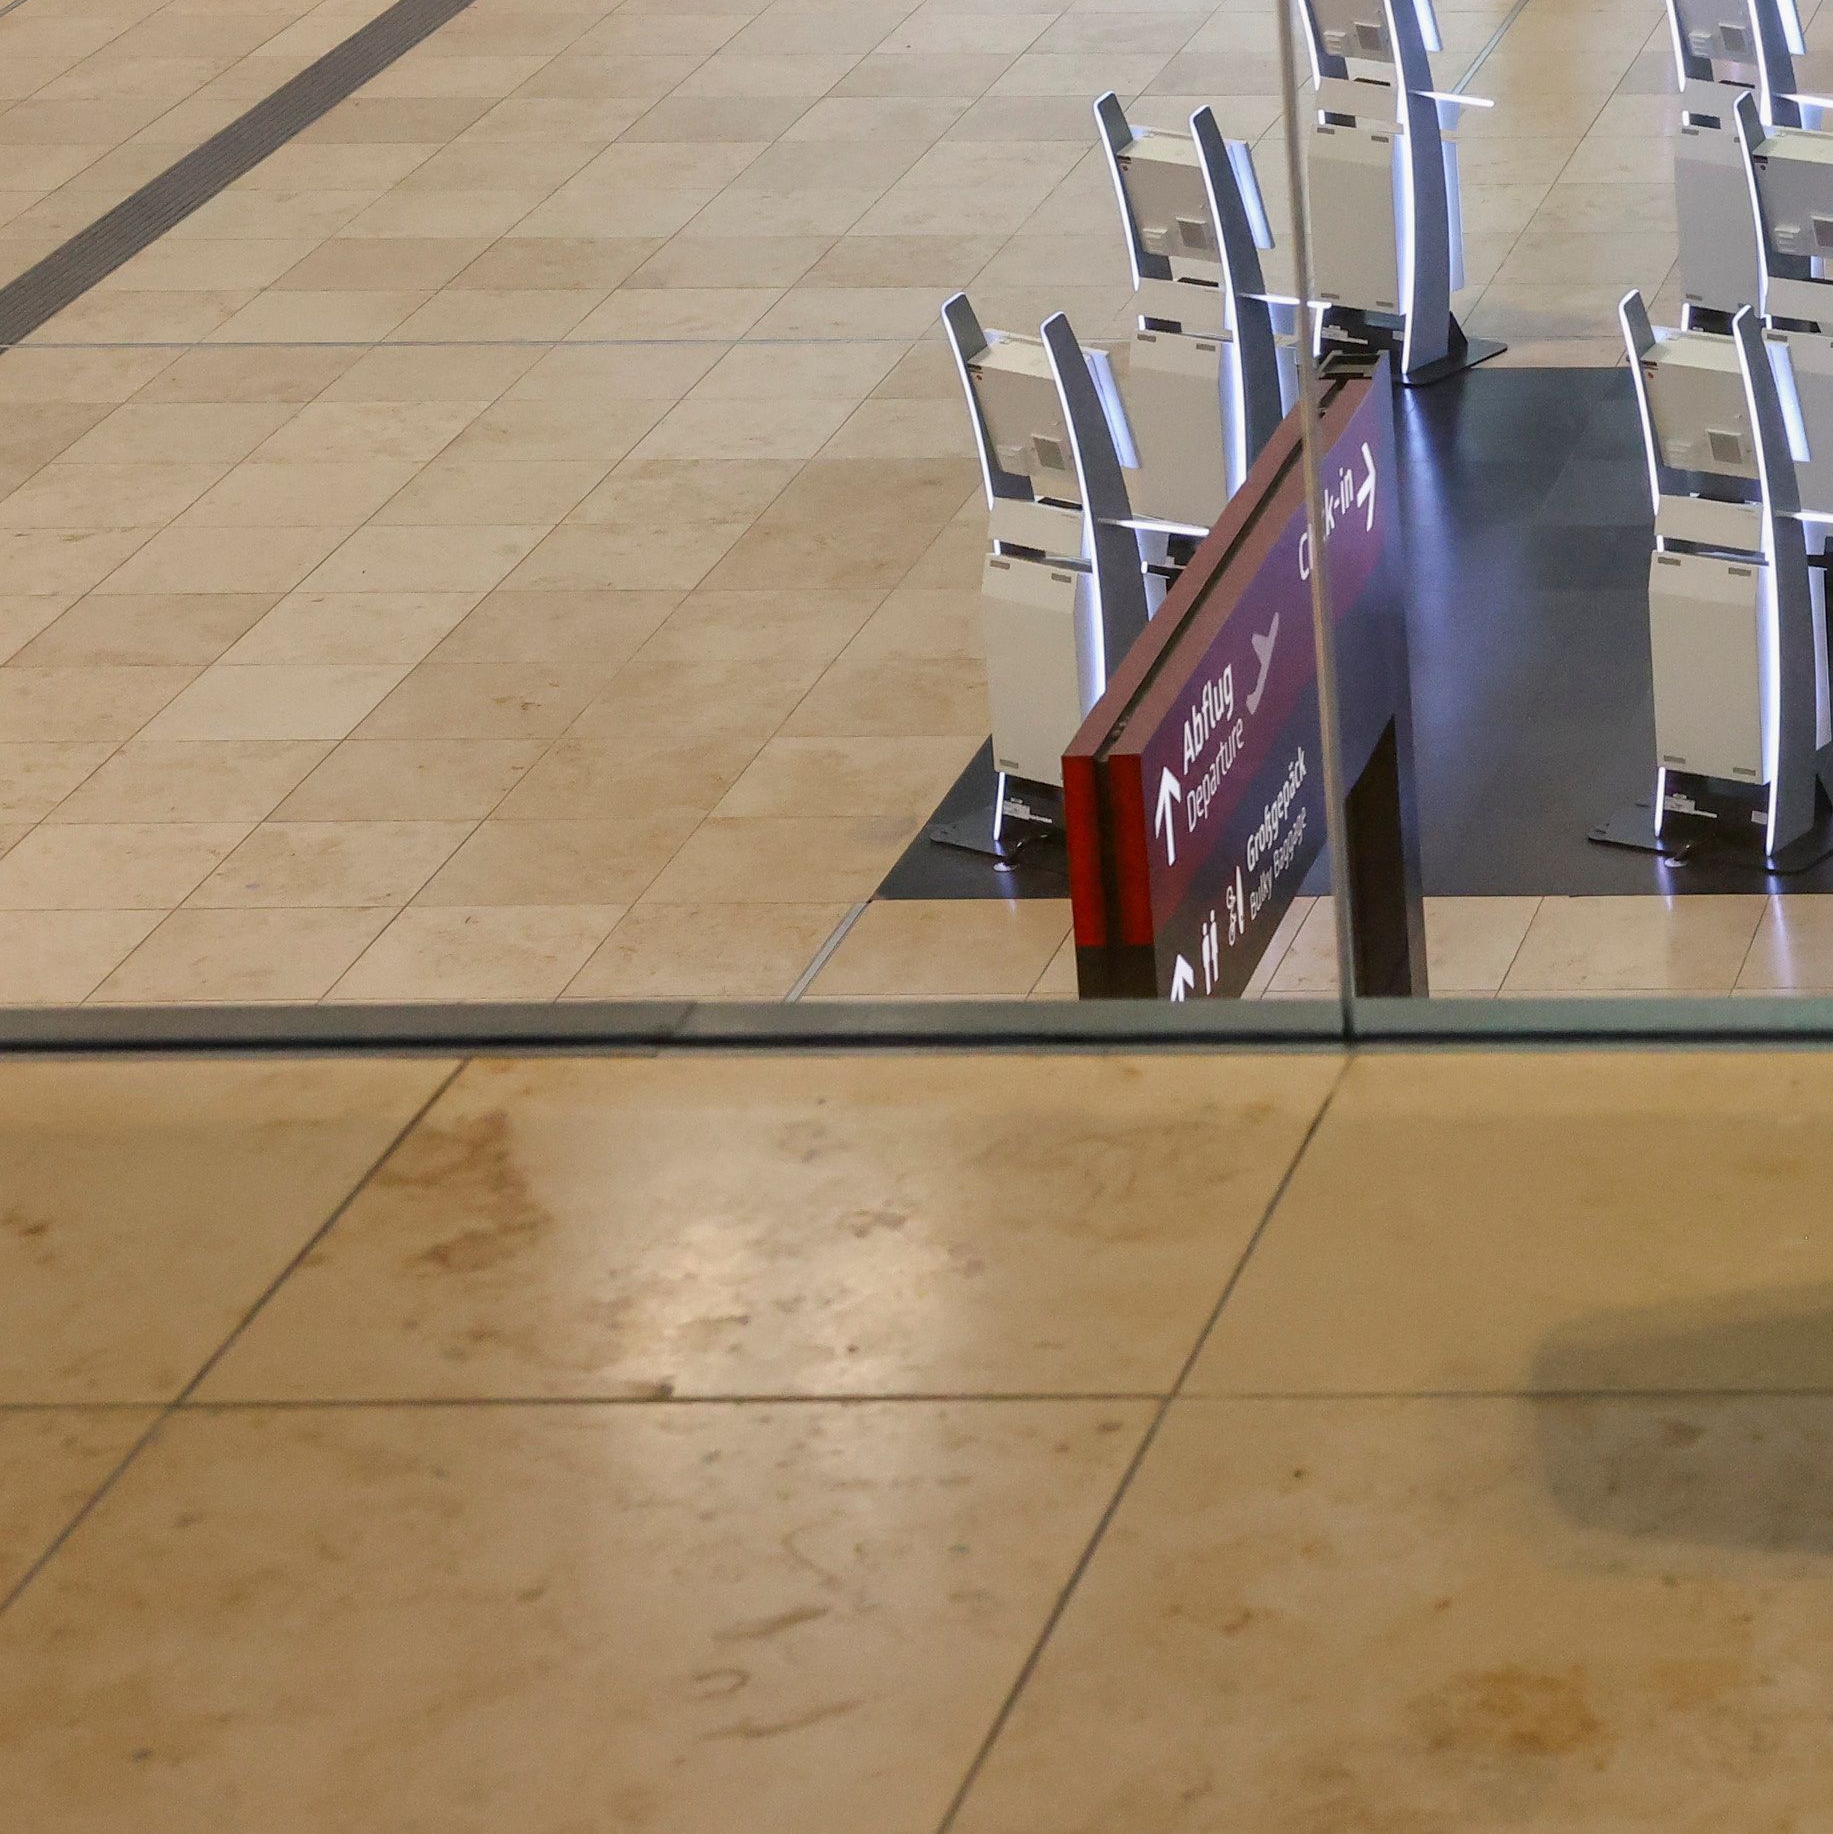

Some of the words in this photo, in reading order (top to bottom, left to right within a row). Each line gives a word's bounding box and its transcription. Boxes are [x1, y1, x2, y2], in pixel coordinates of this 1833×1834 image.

[1184, 663, 1233, 776] Abflug
[1187, 718, 1245, 833] Departure
[1246, 746, 1306, 872] Großgepäck
[1250, 865, 1272, 921] Bulky
[1273, 806, 1307, 880] Baggage
